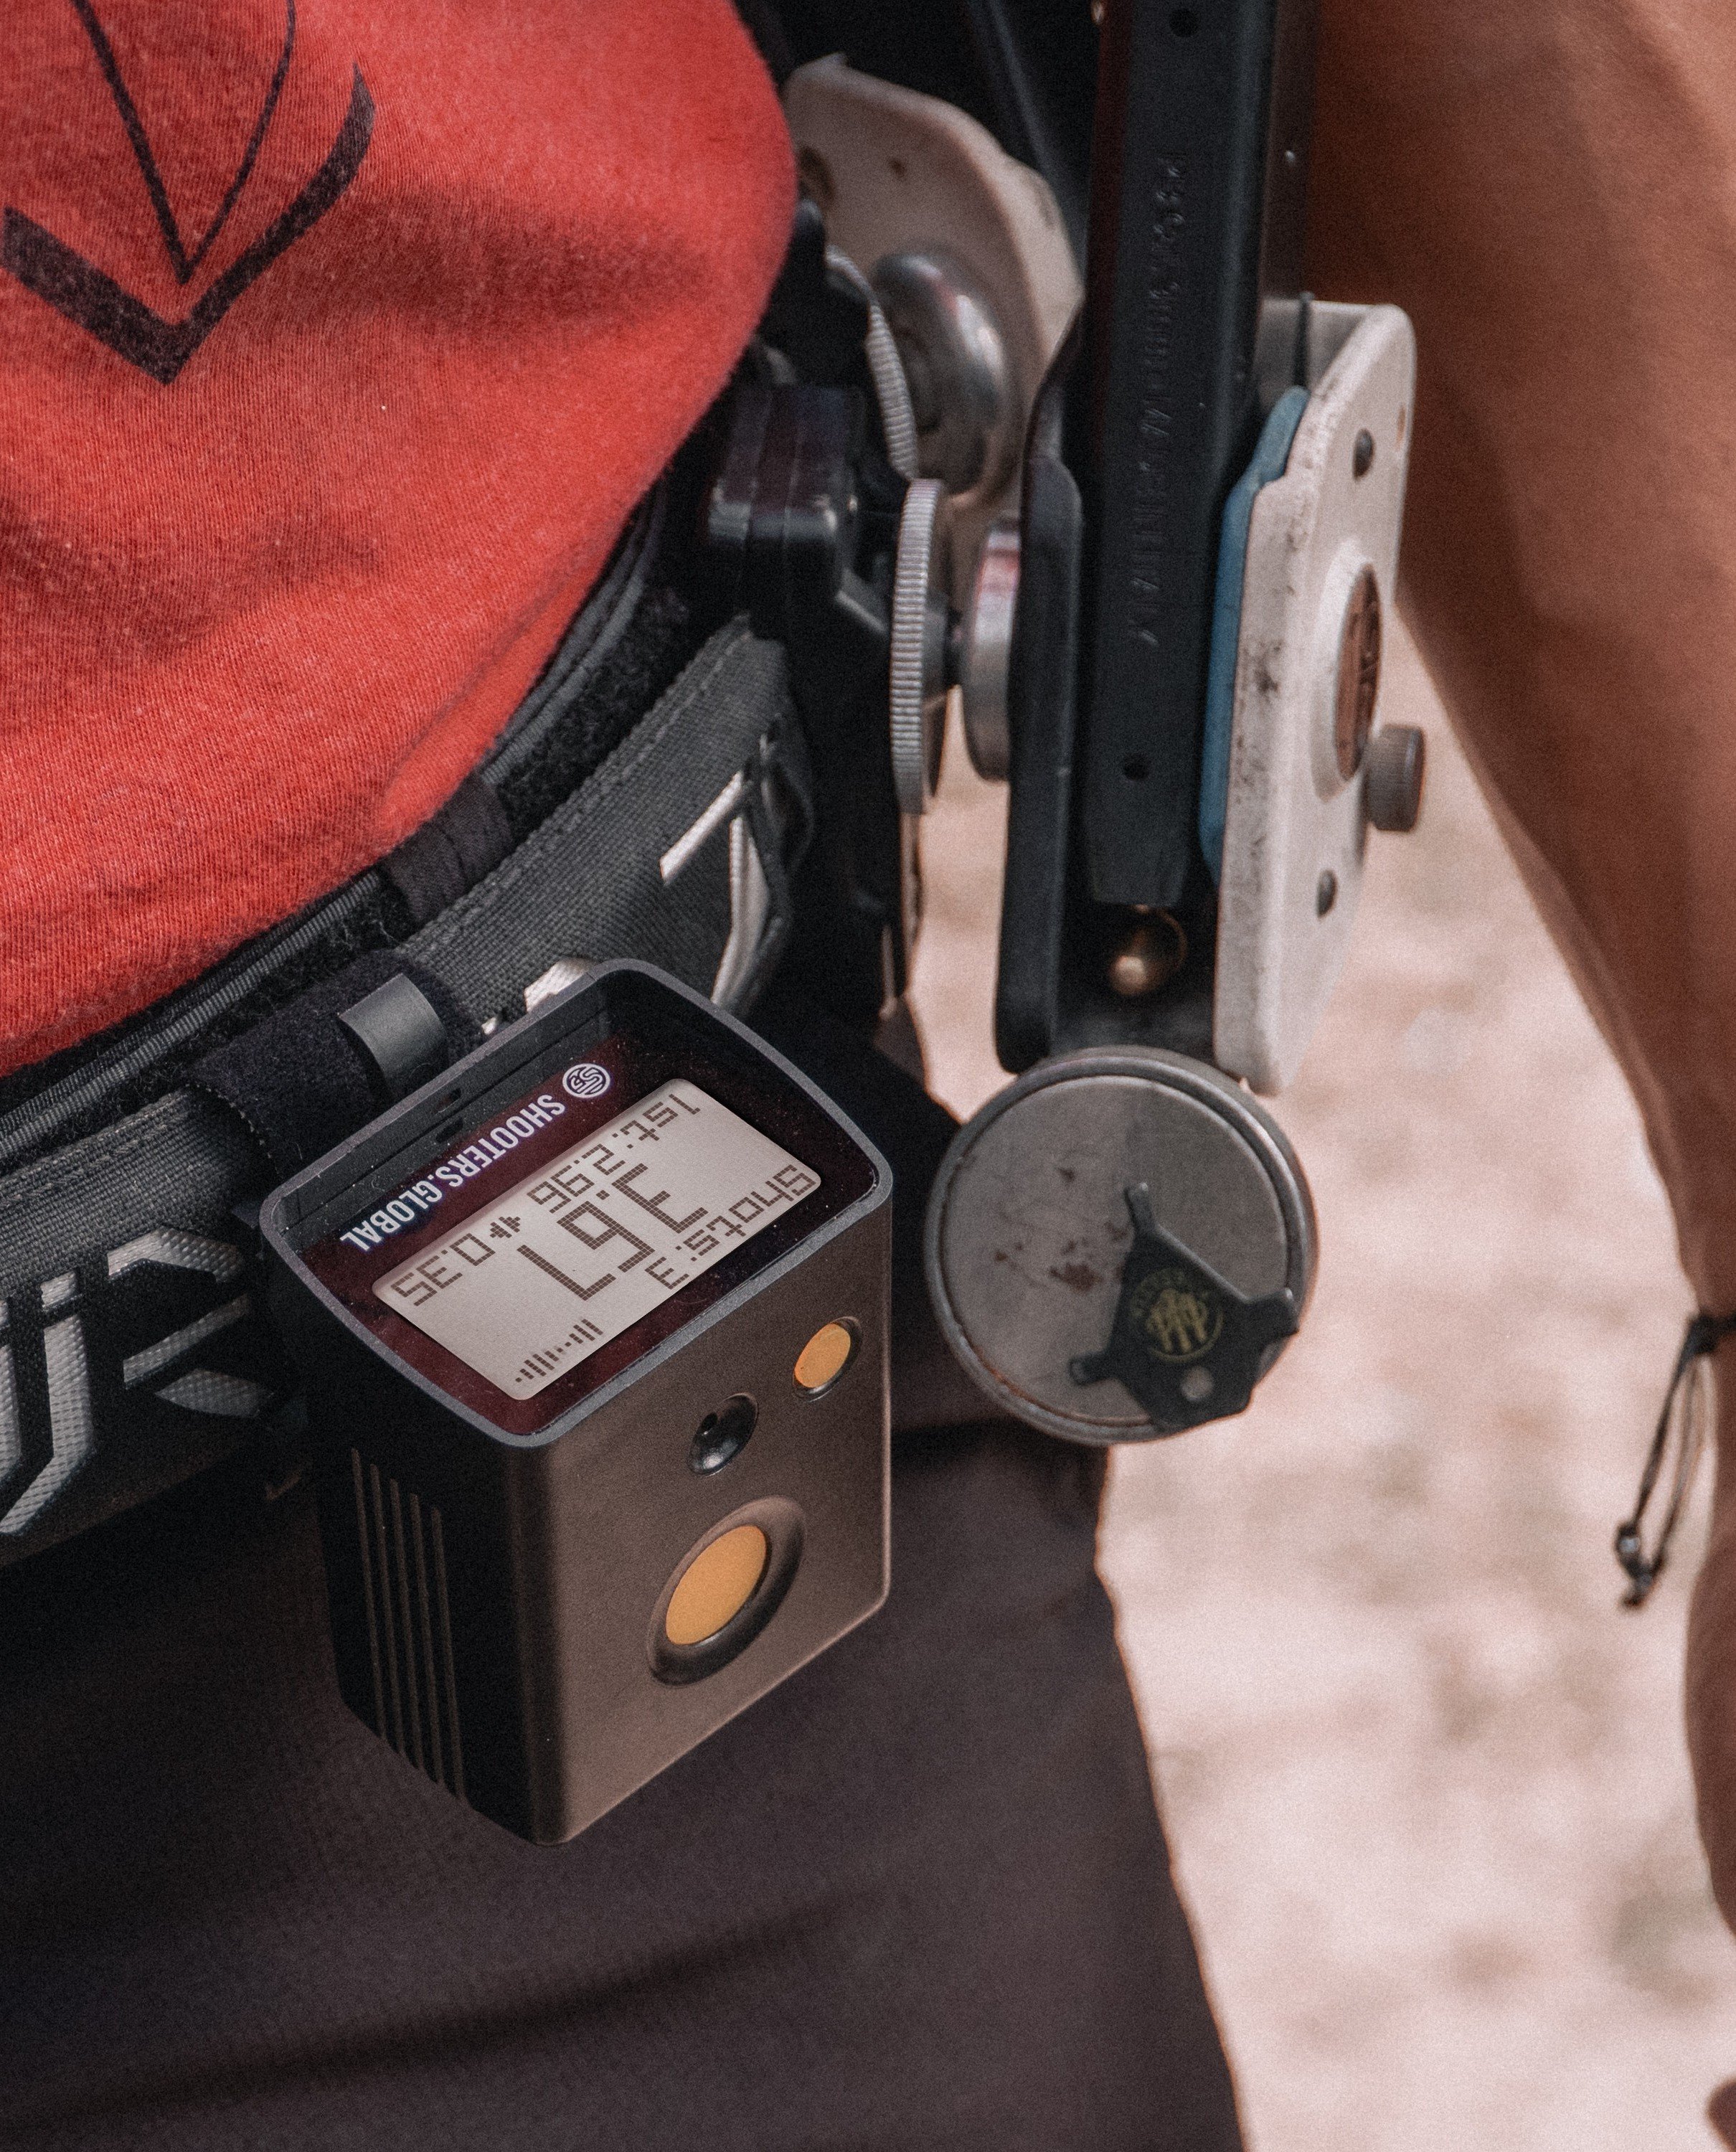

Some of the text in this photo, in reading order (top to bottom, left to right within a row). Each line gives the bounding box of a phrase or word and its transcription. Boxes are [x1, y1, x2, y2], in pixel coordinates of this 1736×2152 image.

[339, 1093, 565, 1252] SHOOTERS.GLOBAL
[390, 1094, 701, 1306] 1st: 2.96 0.35
[516, 1163, 708, 1301] 3.67
[644, 1163, 817, 1290] Shots: 3
